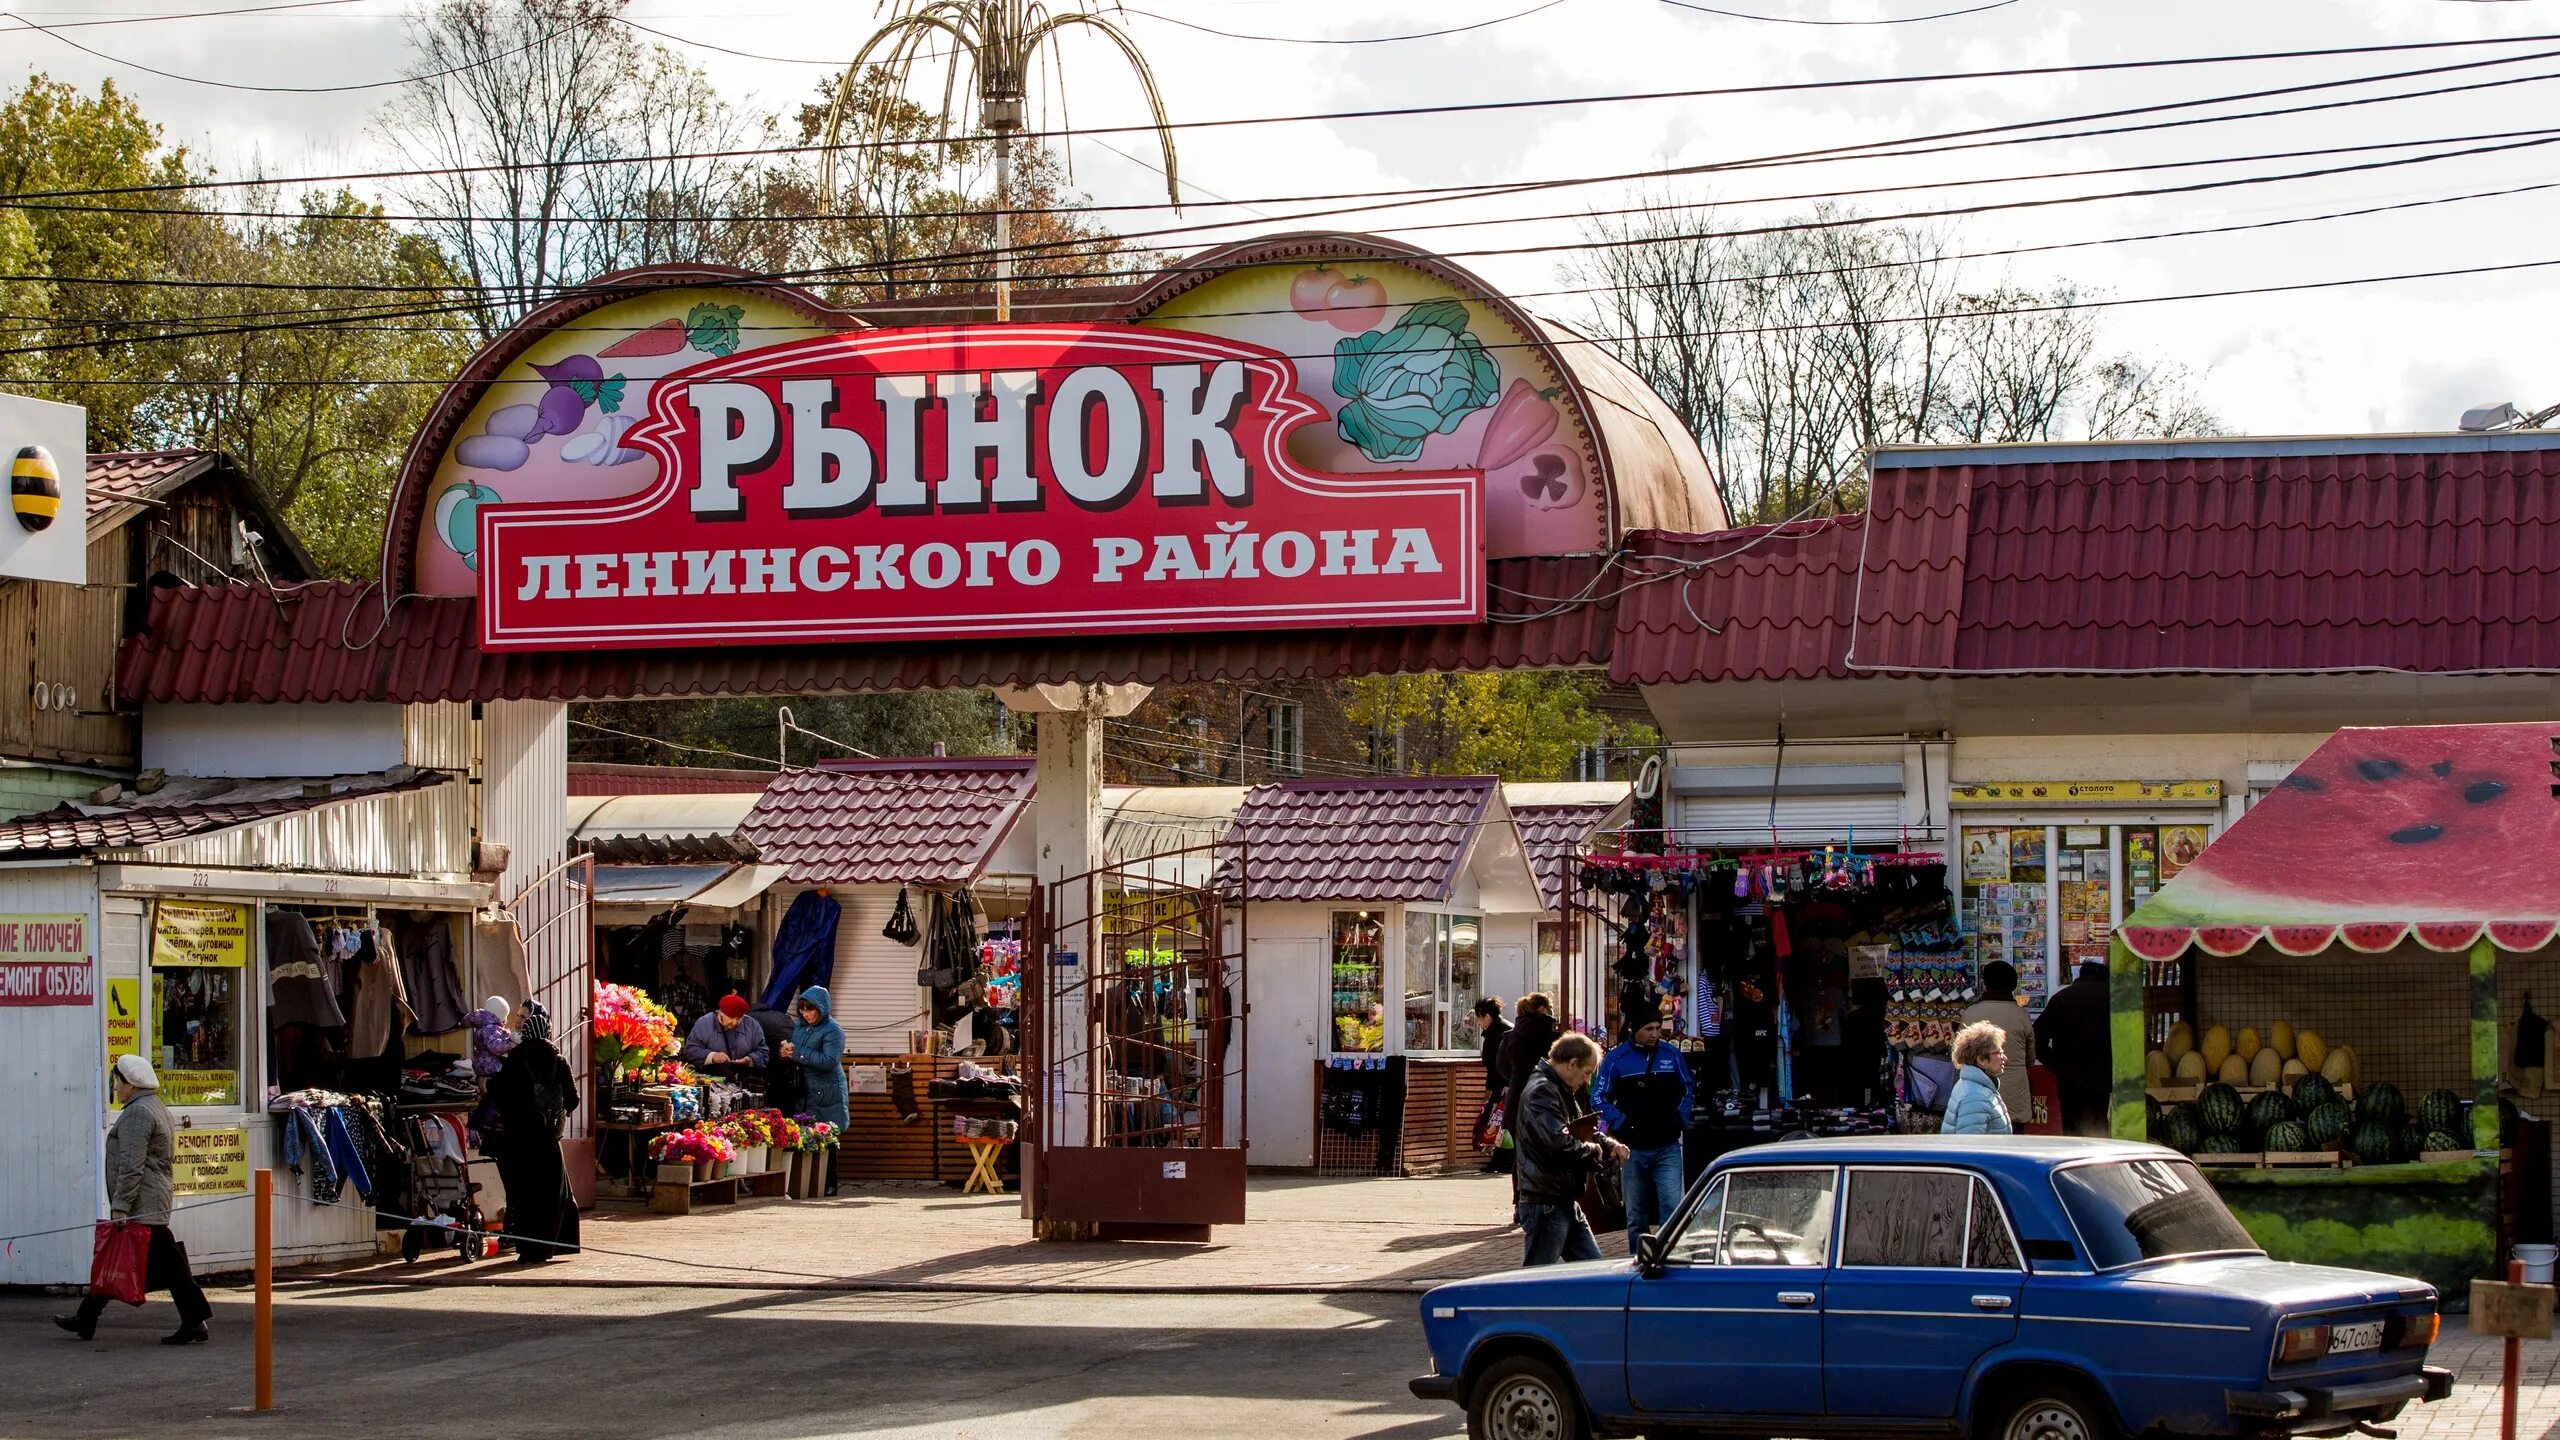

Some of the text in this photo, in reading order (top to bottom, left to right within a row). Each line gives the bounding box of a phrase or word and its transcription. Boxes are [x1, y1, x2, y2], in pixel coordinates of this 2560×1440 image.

[688, 361, 1249, 519] РЫНОК
[517, 520, 1443, 601] ЛЕНИНСКОГО РАЙОНА
[192, 873, 209, 887] 222
[325, 879, 338, 892] 221
[203, 907, 237, 922] СУМОК
[24, 917, 82, 953] КЛЮЧЕЙ
[217, 926, 244, 937] кнопки
[187, 951, 218, 965] бегунок
[46, 966, 92, 996] ОБУВИ
[107, 1017, 136, 1029] РОЧНЫЙ
[107, 1036, 132, 1046] РЕМОНТ
[178, 1134, 240, 1148] РЕМОНТ ОБУВИ
[172, 1150, 245, 1164] ИЗГОТОВЛЕНИЕ КЛЮЧЕЙ
[198, 1165, 229, 1176] ДОМОФОН
[173, 1182, 197, 1192] ЗАТОЧКА
[198, 1180, 216, 1190] НОЖЕЙ
